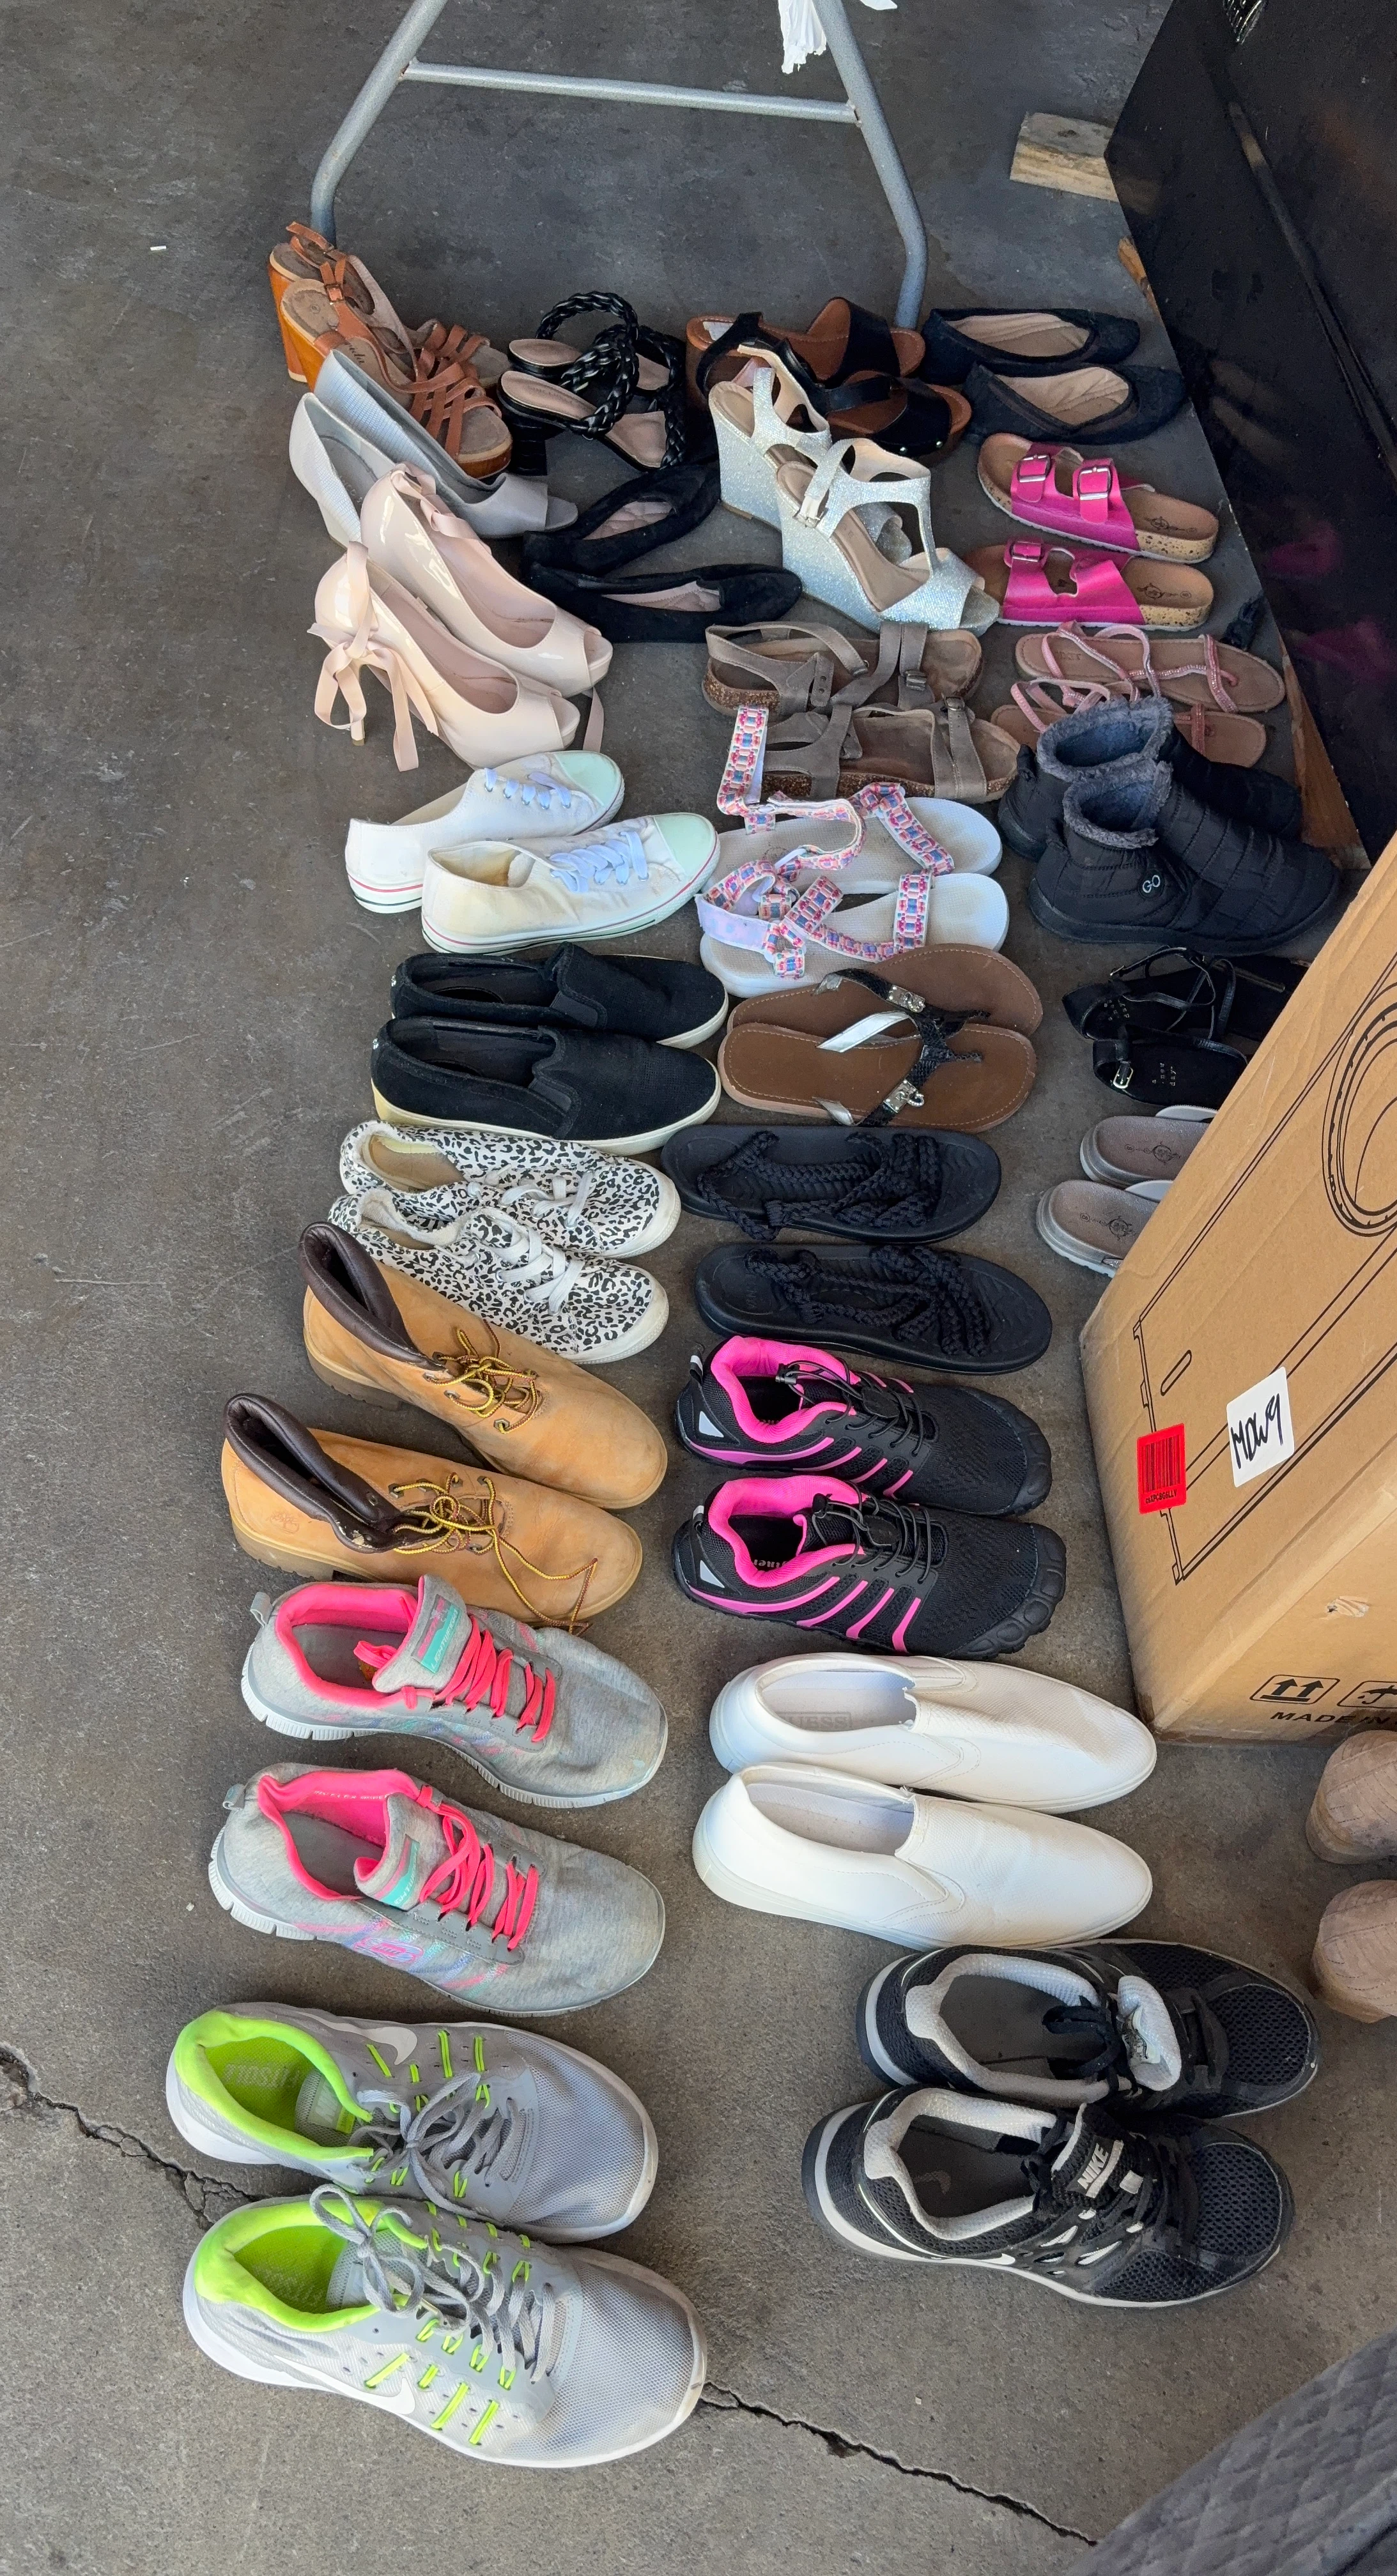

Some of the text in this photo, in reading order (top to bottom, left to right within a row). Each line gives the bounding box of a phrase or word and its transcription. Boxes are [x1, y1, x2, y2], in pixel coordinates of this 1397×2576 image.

[1142, 875, 1161, 893] GO
[781, 1716, 848, 1729] UESS
[1270, 1712, 1356, 1723] MADE
[1077, 2143, 1109, 2190] NIKE
